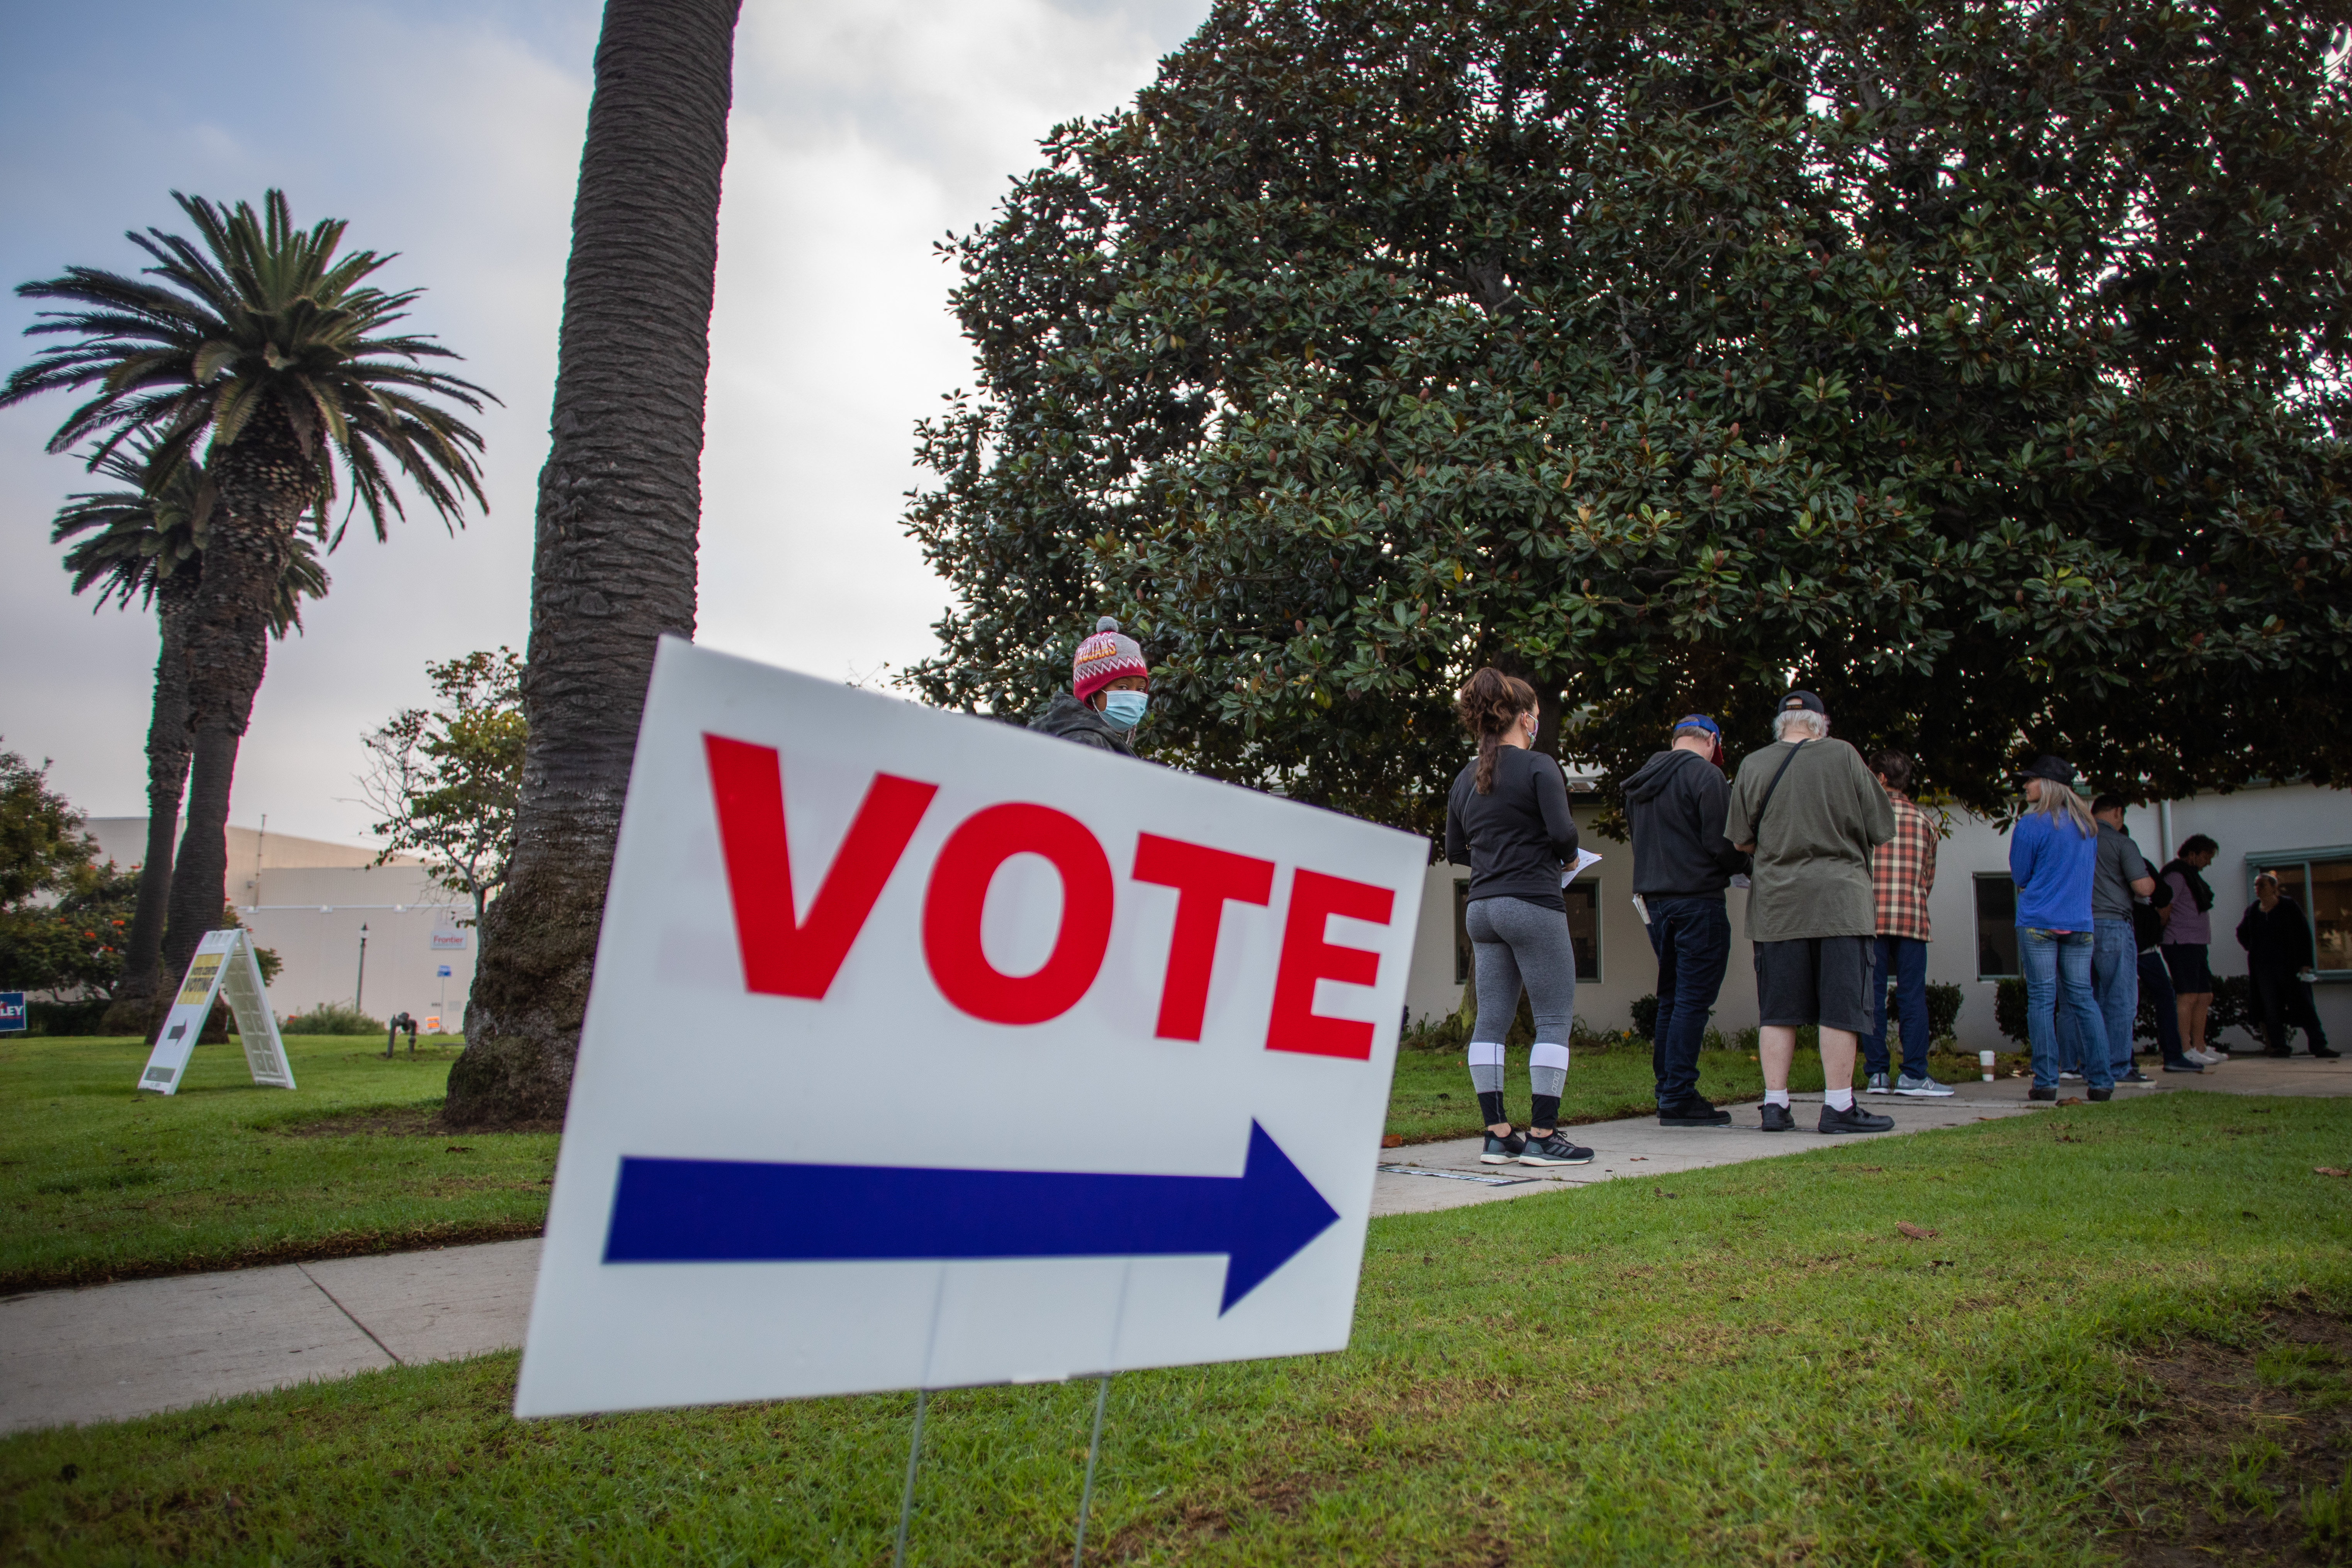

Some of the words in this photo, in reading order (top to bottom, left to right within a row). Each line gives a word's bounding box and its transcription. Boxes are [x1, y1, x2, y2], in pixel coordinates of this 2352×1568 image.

[705, 735, 1395, 1060] VOTE
[433, 935, 463, 943] Frontier
[183, 977, 215, 992] VOTING
